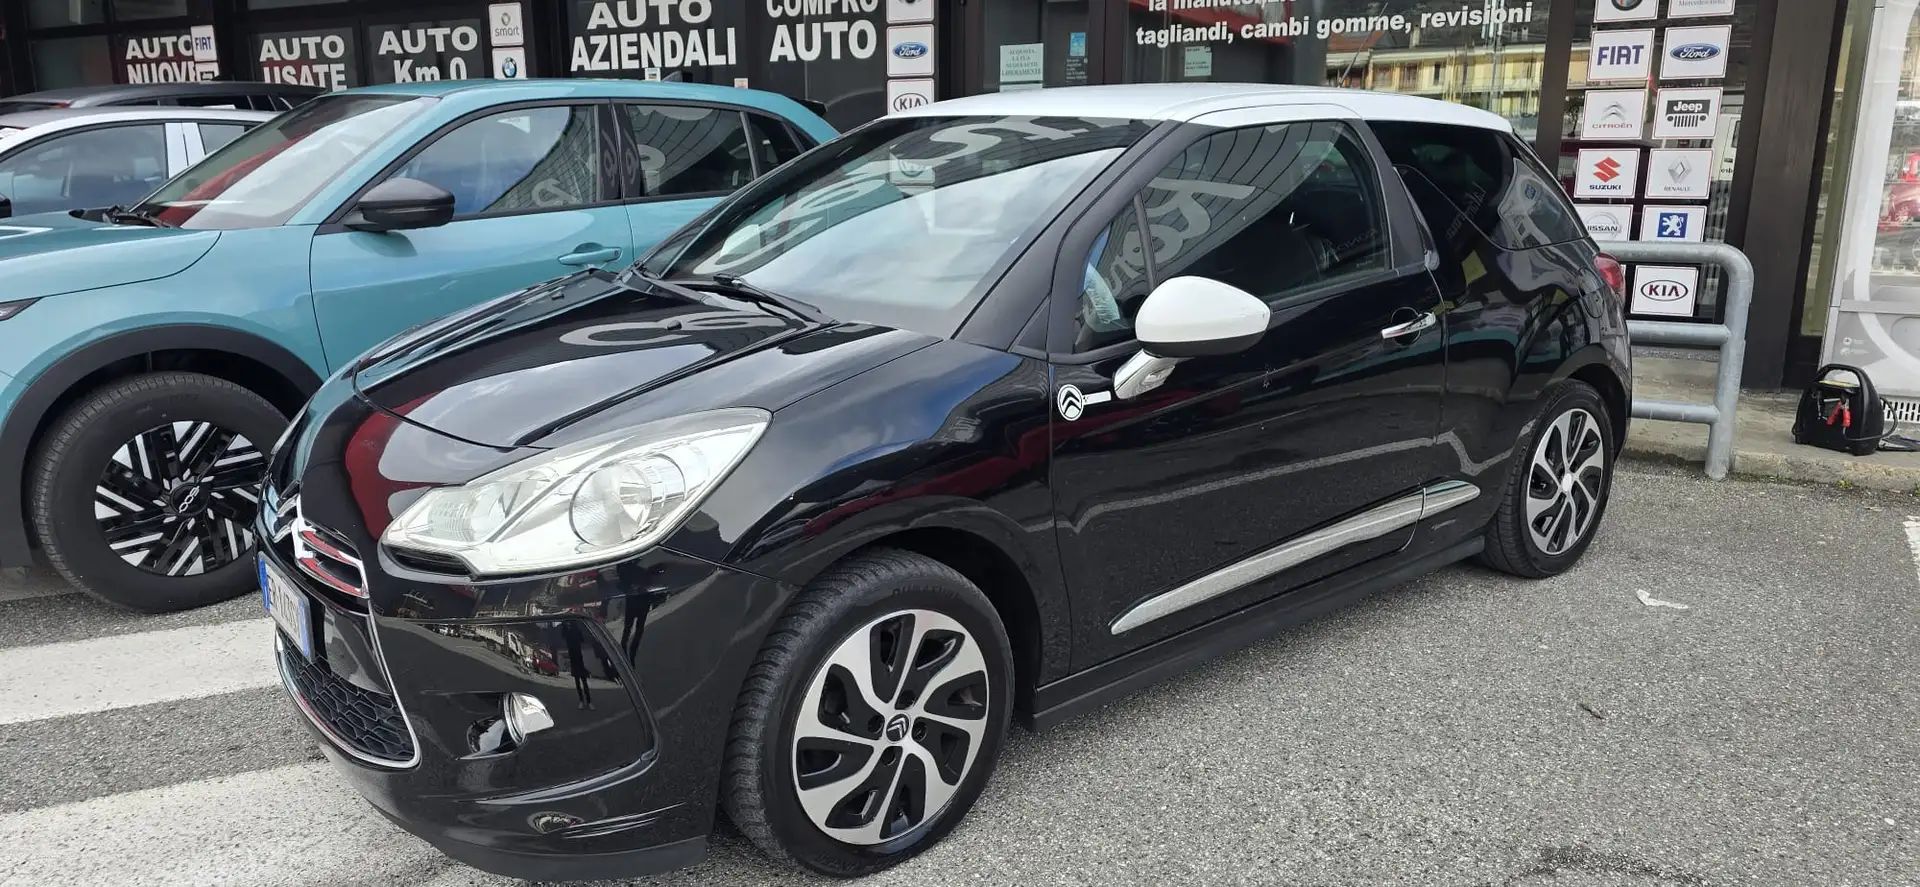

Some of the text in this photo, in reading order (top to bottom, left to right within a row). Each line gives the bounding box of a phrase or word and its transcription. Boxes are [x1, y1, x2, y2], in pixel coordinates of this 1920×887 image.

[587, 0, 712, 30] AUTO
[1136, 1, 1532, 48] tagliandi, cambi gomme, revisioni
[378, 26, 478, 55] AUTO
[494, 27, 520, 36] smart
[769, 19, 877, 62] AUTO
[126, 36, 193, 60] AUTO
[259, 35, 345, 62] AUTO
[570, 27, 737, 72] AZIENDALI
[899, 44, 922, 56] Ford
[1597, 44, 1645, 66] FIAT
[1680, 47, 1710, 58] Ford
[263, 63, 348, 92] USATE
[393, 57, 468, 84] Km 0
[899, 97, 922, 110] KIA
[1673, 101, 1703, 112] Jeep
[1648, 284, 1680, 297] KIA
